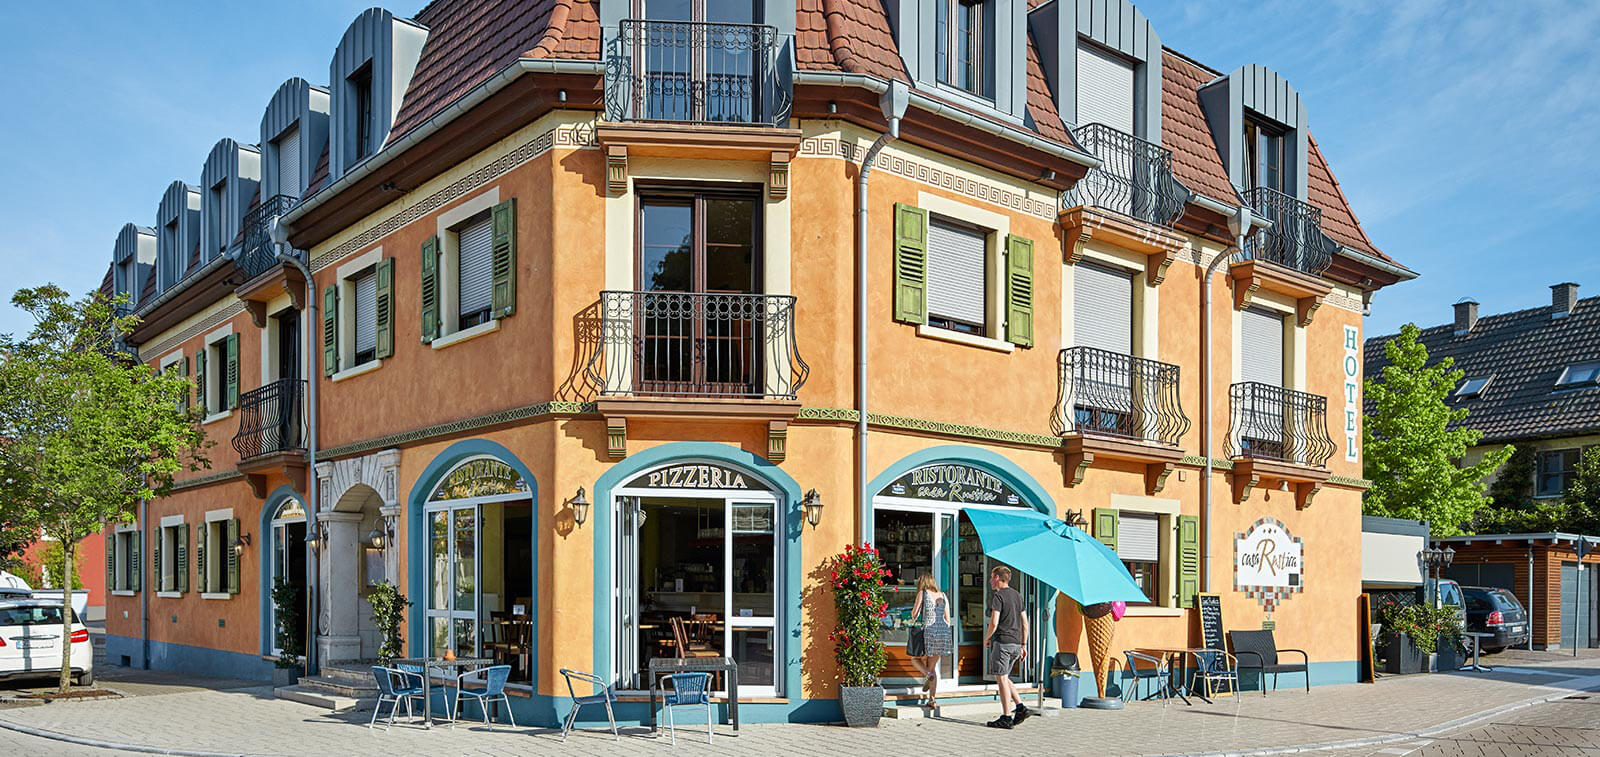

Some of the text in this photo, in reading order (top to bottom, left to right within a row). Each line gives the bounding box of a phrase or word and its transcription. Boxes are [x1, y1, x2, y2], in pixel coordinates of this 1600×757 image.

[1345, 328, 1357, 458] HOTEL
[449, 460, 511, 487] RISTORANTE
[648, 465, 748, 489] PIZZERIA
[911, 465, 1002, 494] RISTORANTE
[917, 486, 947, 498] casa
[948, 482, 997, 503] Rustica
